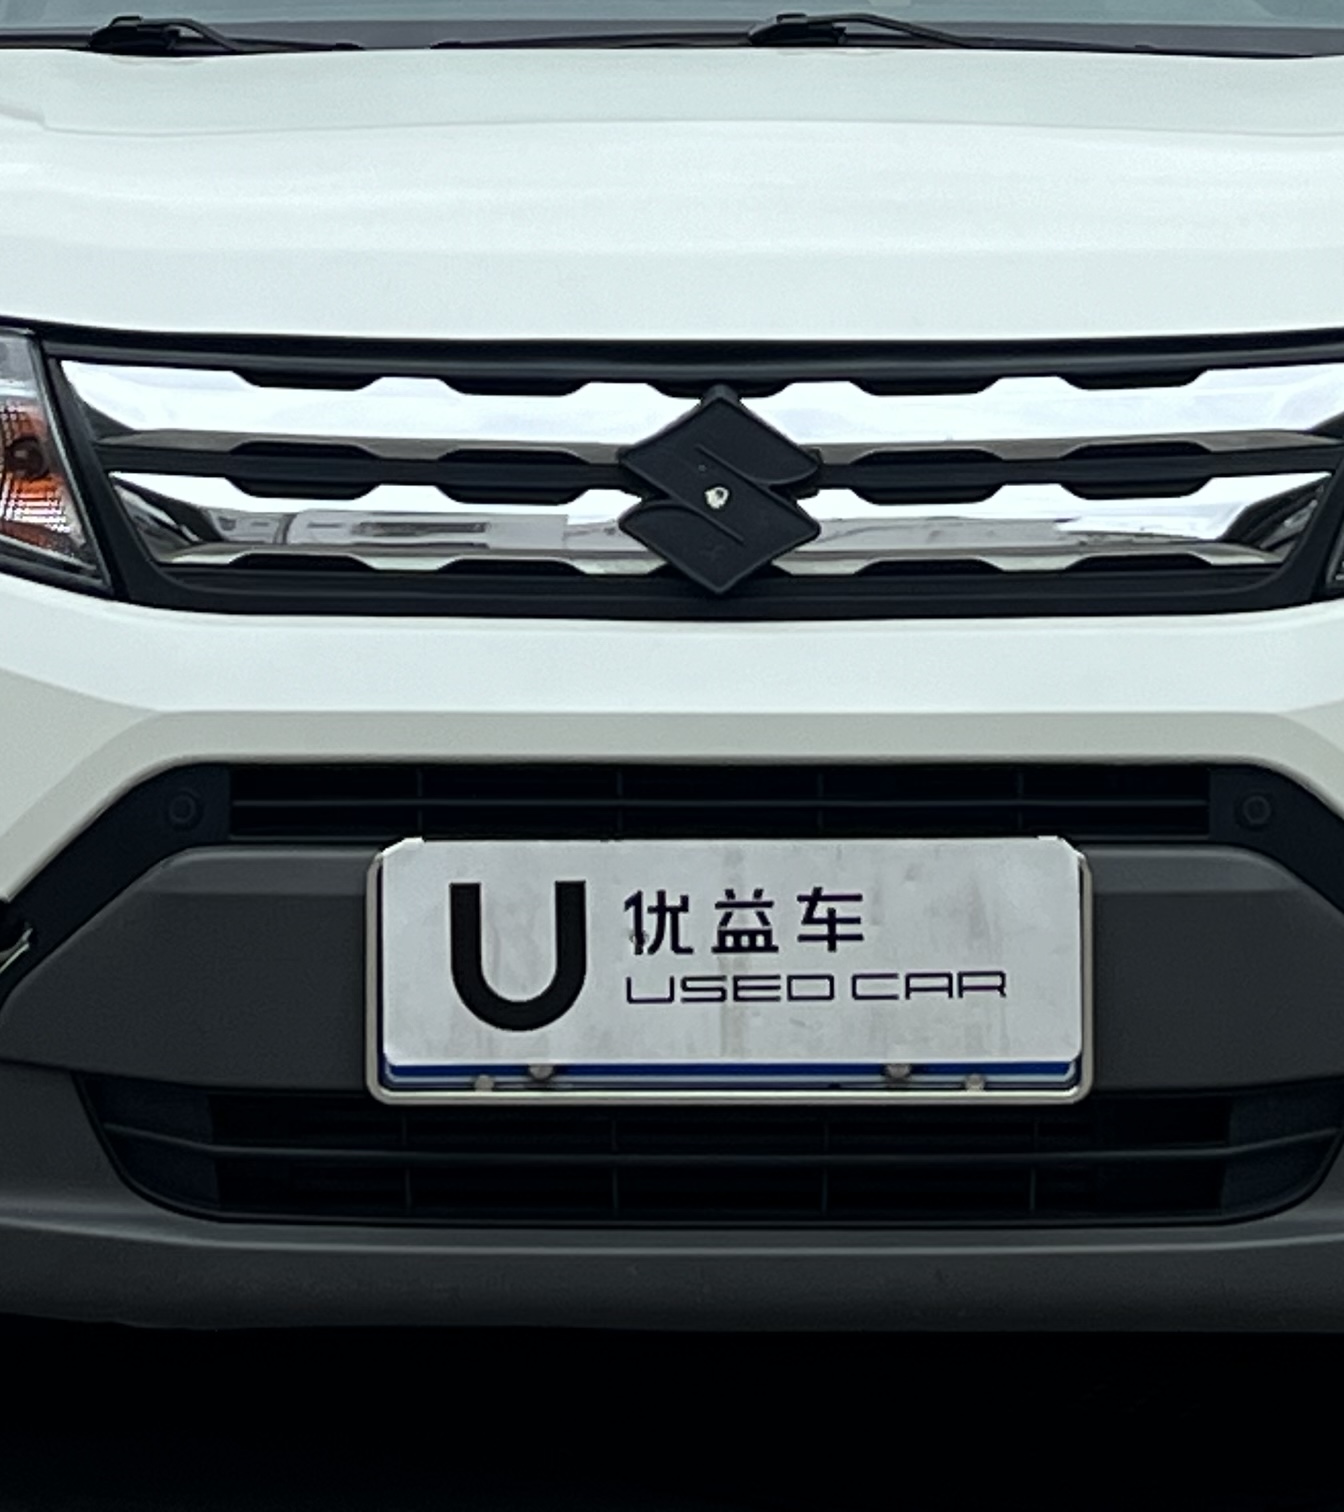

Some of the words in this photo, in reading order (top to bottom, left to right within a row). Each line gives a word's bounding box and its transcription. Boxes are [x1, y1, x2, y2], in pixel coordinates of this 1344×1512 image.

[448, 879, 588, 1033] U
[623, 886, 865, 956] 优益车
[625, 973, 836, 1005] USED
[850, 970, 1007, 1001] CAR
